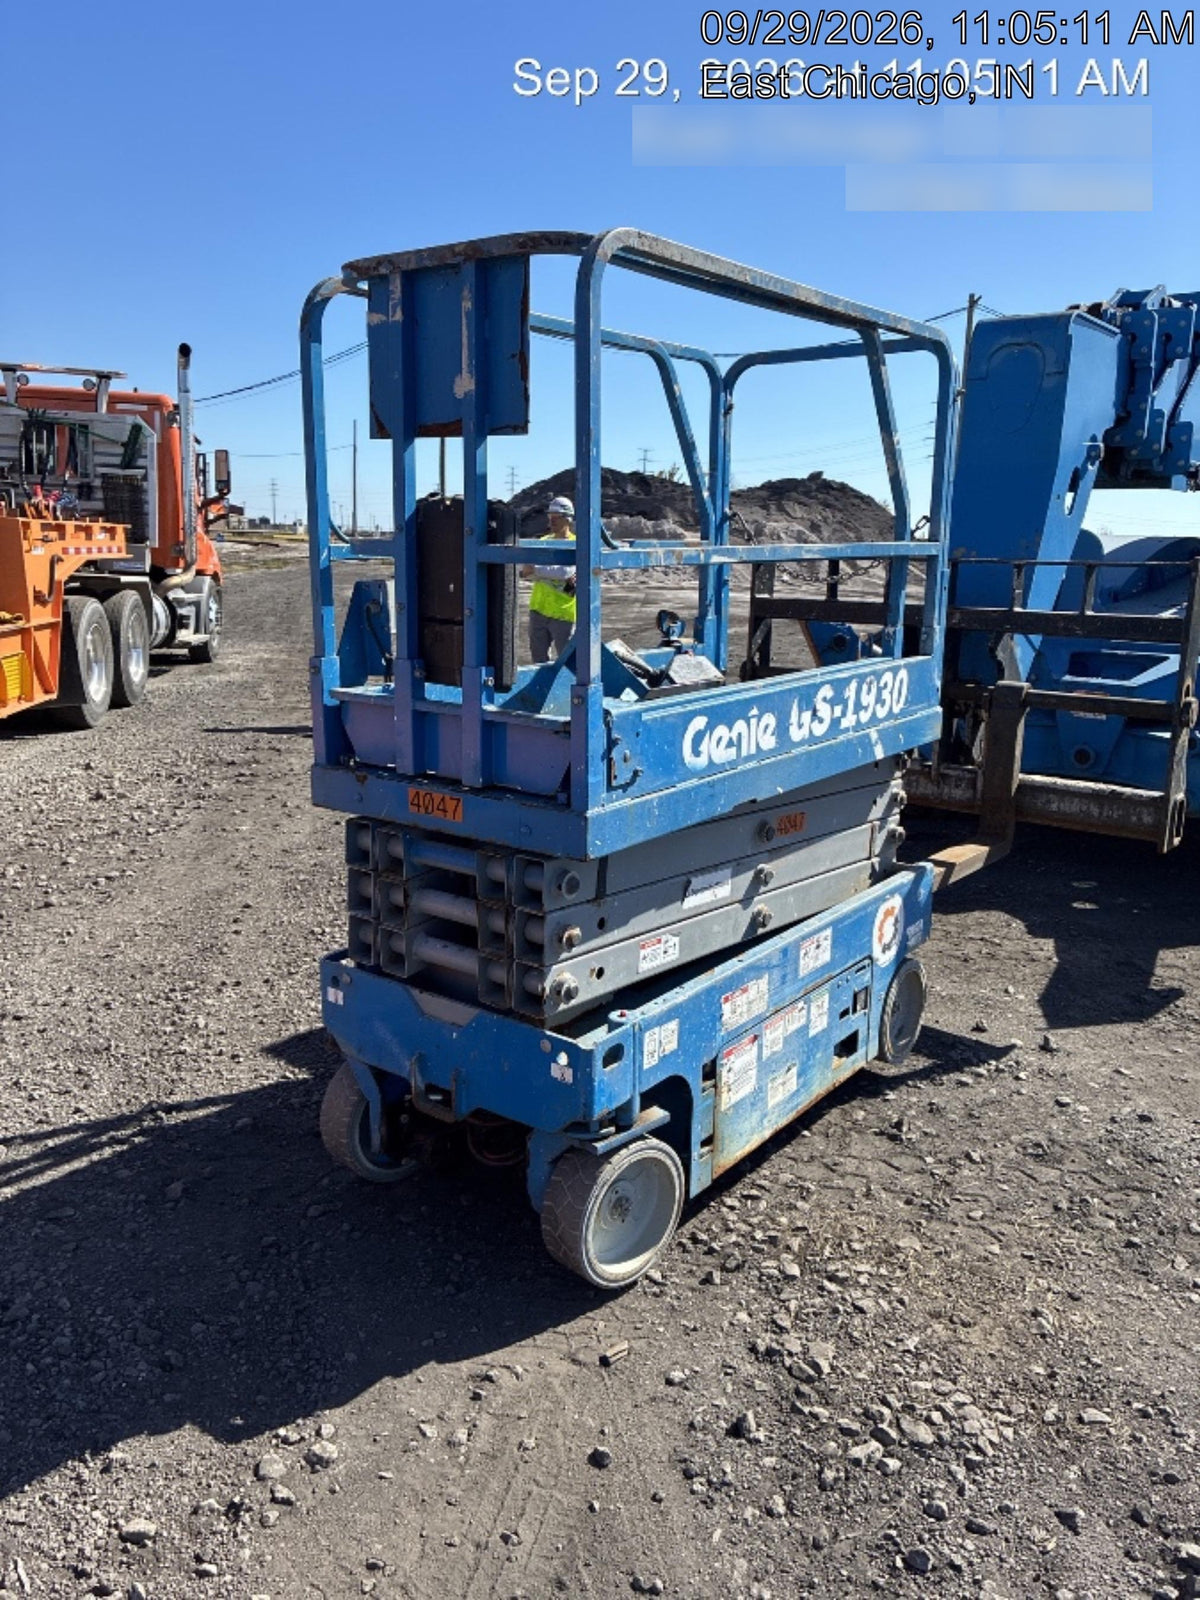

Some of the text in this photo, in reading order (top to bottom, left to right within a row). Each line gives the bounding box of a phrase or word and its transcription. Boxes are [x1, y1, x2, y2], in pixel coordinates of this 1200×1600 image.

[682, 668, 909, 770] Genie GS-1930
[410, 790, 462, 820] 4047
